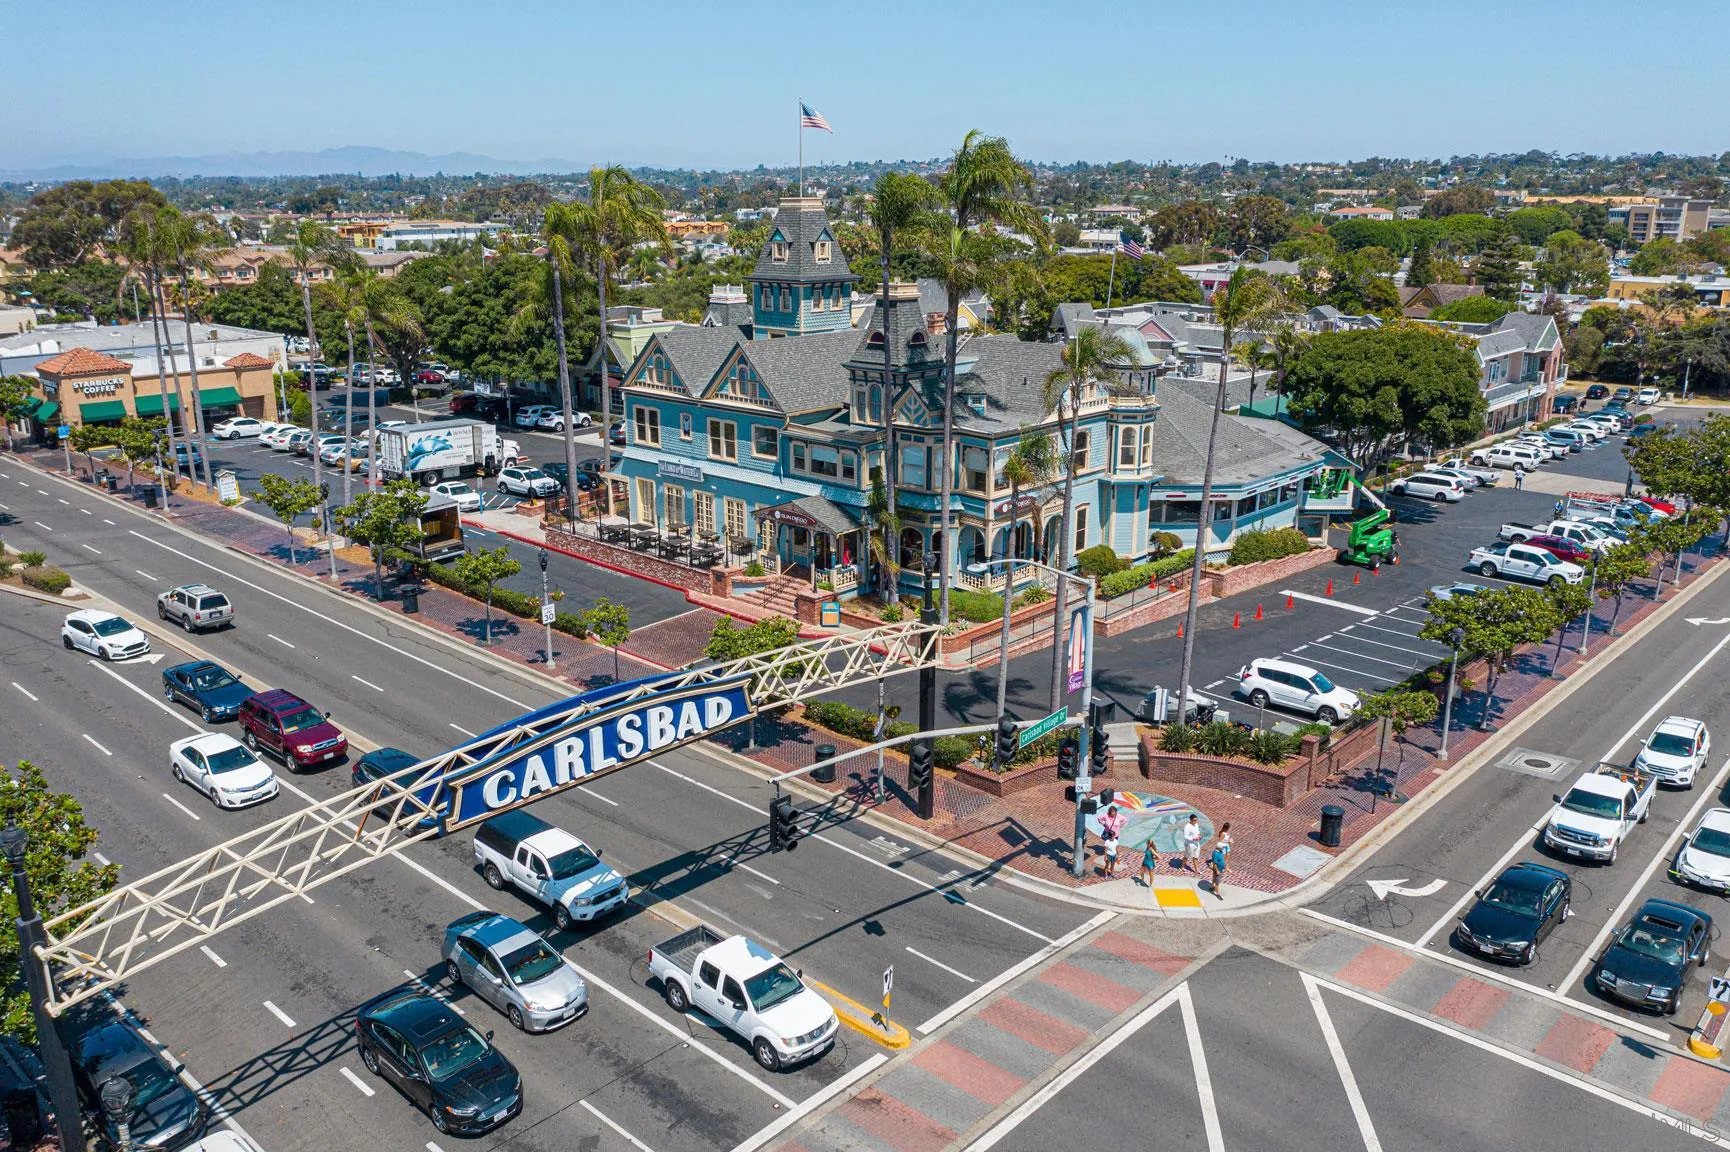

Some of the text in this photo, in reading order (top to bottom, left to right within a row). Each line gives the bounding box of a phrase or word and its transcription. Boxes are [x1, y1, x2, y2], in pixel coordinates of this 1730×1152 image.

[73, 377, 124, 389] STARBUCKS
[83, 385, 116, 394] COFFEE
[544, 613, 553, 621] 30
[1021, 725, 1043, 743] Carlsbad
[1043, 716, 1059, 730] Village
[483, 696, 733, 809] CARLSBAD
